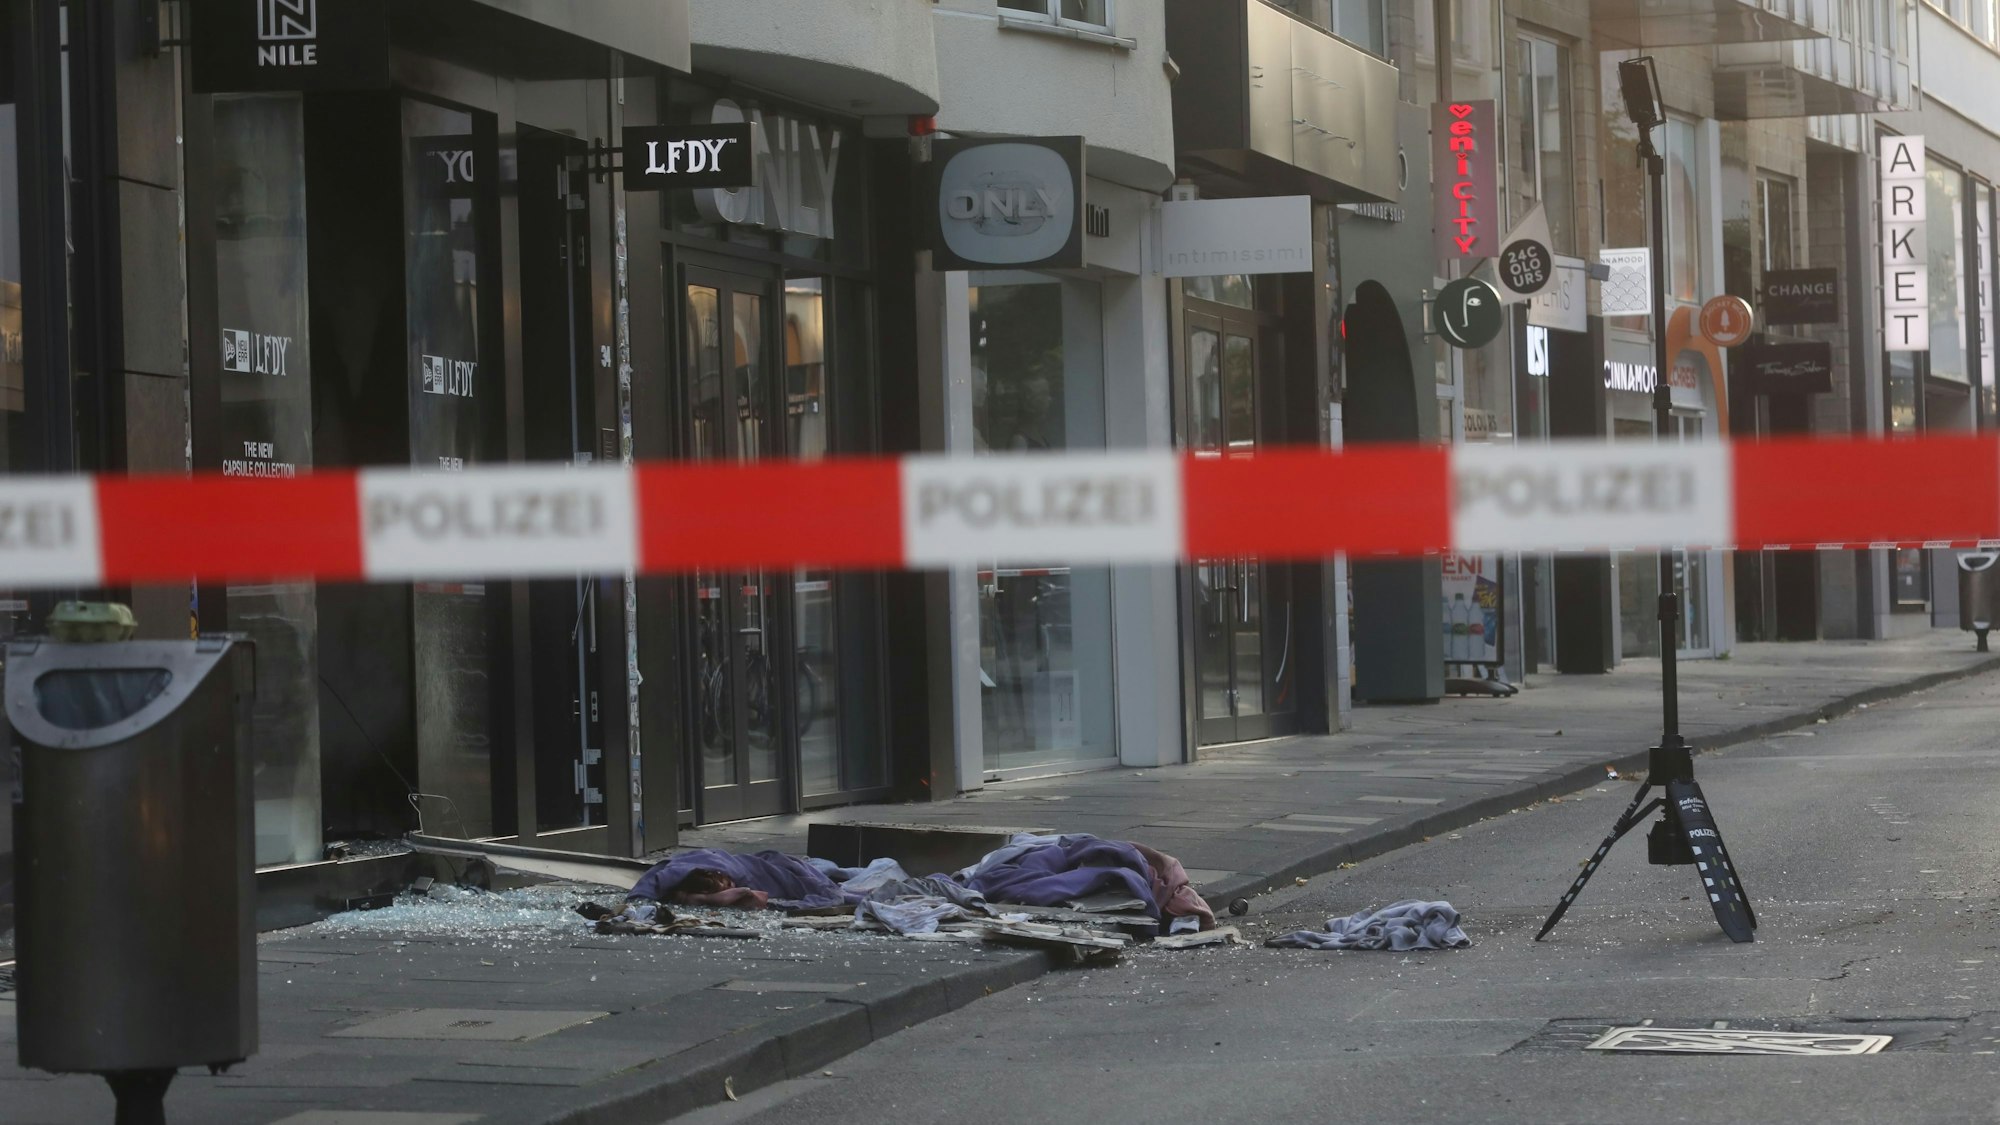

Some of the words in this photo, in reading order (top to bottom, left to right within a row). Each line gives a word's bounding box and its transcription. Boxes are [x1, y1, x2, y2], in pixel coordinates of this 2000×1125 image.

[258, 45, 317, 66] NILE
[948, 185, 1063, 222] ONLY
[1889, 142, 1919, 345] ARKET
[1169, 248, 1304, 265] intimissimi
[1769, 282, 1834, 297] CHANGE
[601, 345, 611, 368] 34
[243, 441, 258, 457] THE
[258, 442, 274, 459] NEW
[222, 460, 253, 477] CAPSULE
[254, 461, 295, 478] COLLECTION
[438, 456, 450, 471] THE
[450, 457, 464, 472] NEW
[1456, 465, 1695, 518] POLIZEI
[917, 477, 1157, 531] POLIZEI
[367, 490, 606, 541] POLIZEI
